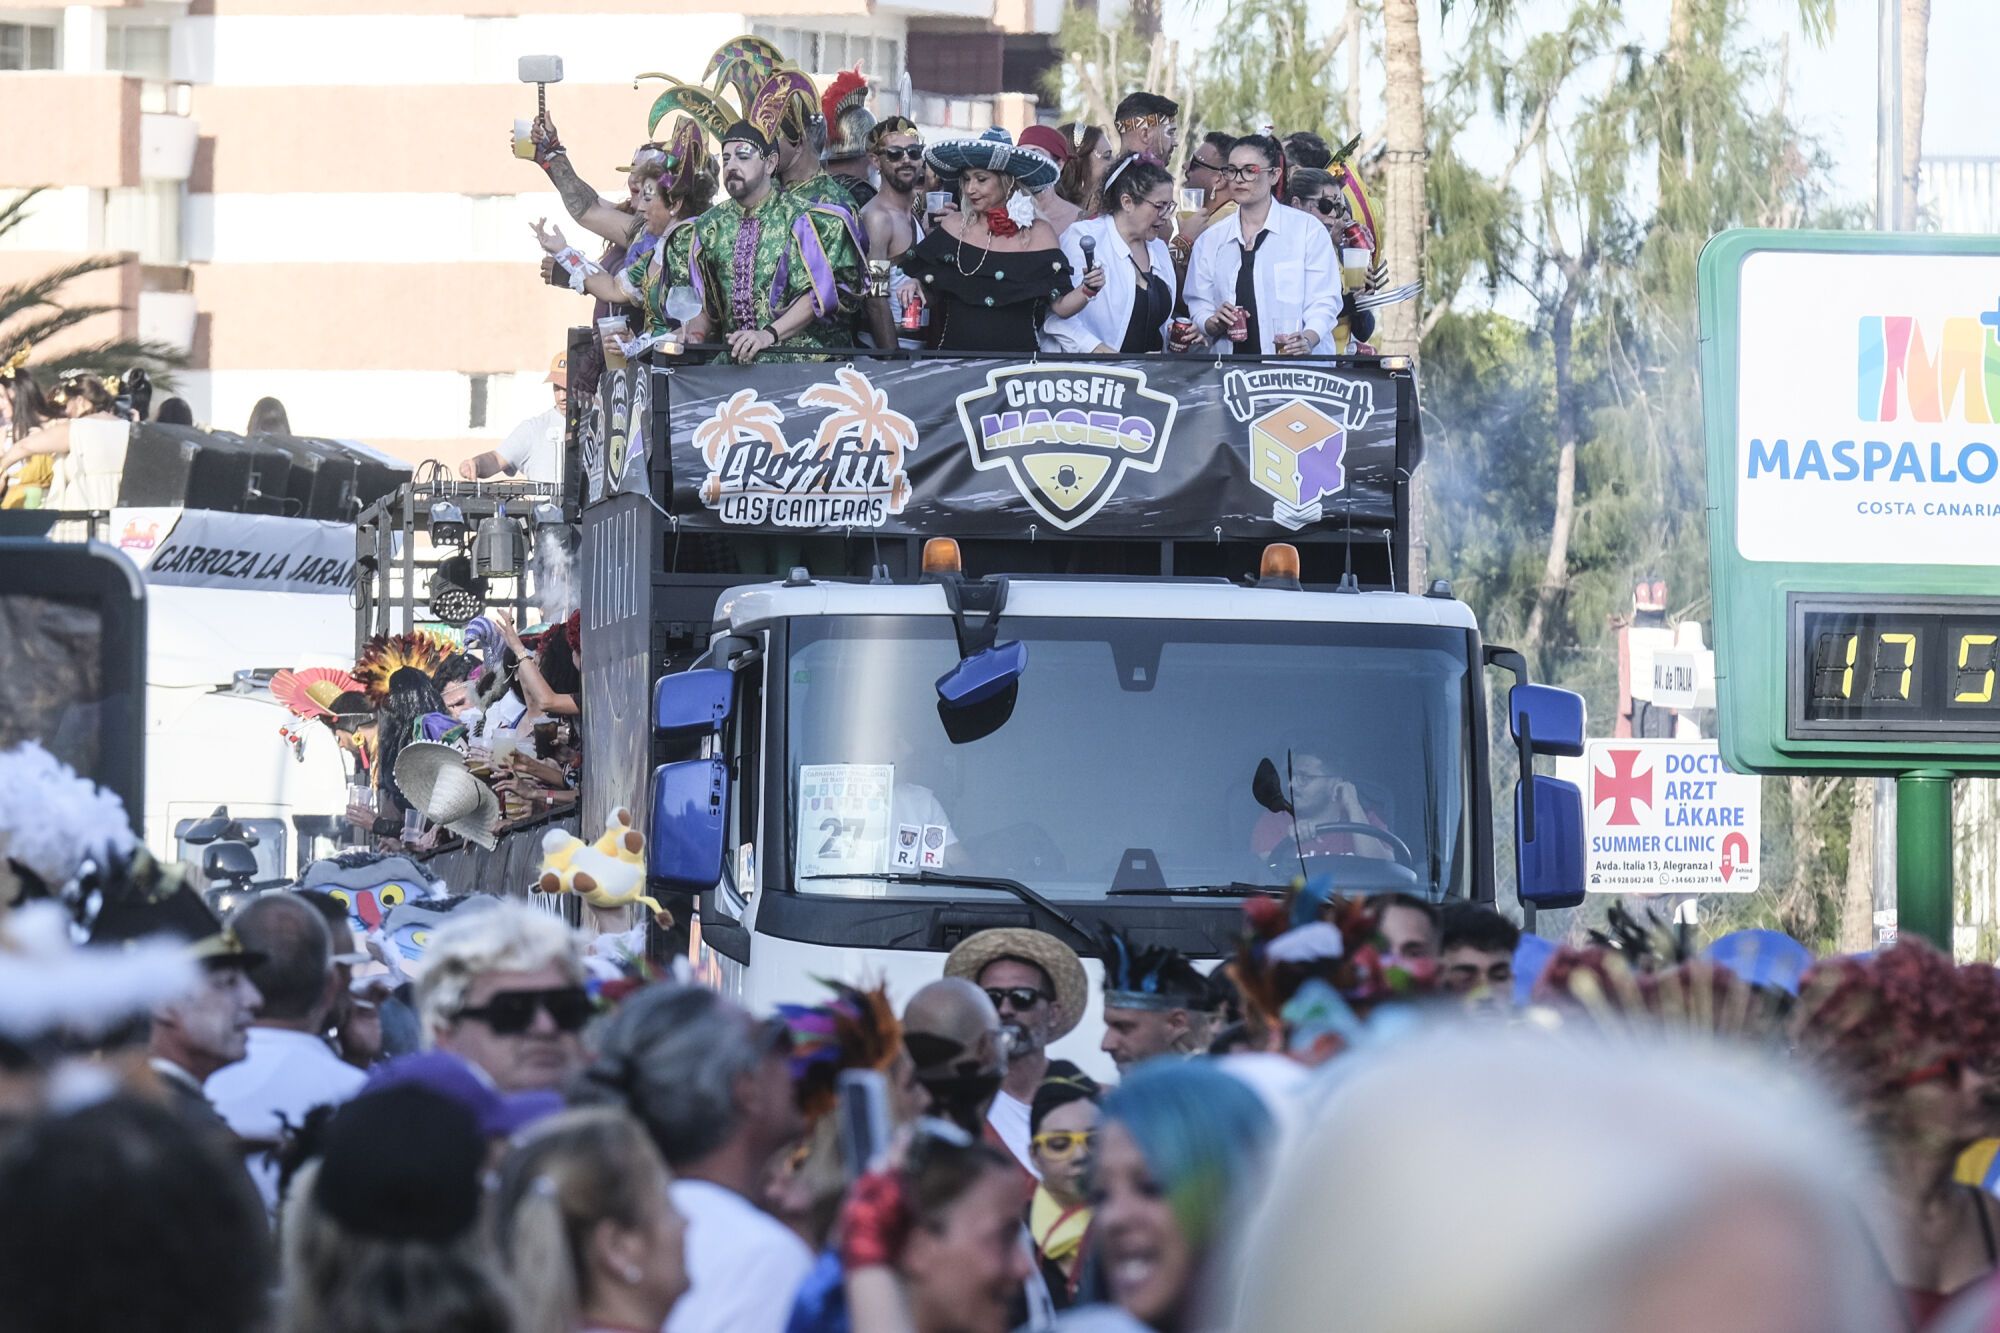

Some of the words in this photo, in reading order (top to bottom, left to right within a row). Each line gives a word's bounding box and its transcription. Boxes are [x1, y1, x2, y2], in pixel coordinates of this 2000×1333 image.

[1005, 377, 1126, 409] CrossFit
[1247, 372, 1351, 400] CONNECTION
[980, 409, 1156, 453] MAGEC
[724, 496, 766, 520] LAS
[775, 498, 883, 523] CANTERAS
[1857, 501, 1916, 515] COSTA
[152, 545, 255, 579] CARROZA
[253, 553, 290, 580] LA
[590, 507, 638, 632] ZIEGEL
[1654, 664, 1664, 690] AV.
[1665, 665, 1673, 690] de
[1674, 666, 1692, 692] ITALIA
[1665, 781, 1717, 800] ARZT
[1665, 803, 1744, 827] LÄKARE
[818, 817, 866, 859] 27
[1592, 835, 1660, 852] SUMMER
[1664, 835, 1715, 852] CLINIC
[898, 851, 913, 865] R.
[924, 852, 940, 865] R.
[1595, 860, 1621, 871] Avda.
[1623, 860, 1646, 871] Italia
[1648, 860, 1661, 872] 13,
[1663, 860, 1708, 873] Alegranza
